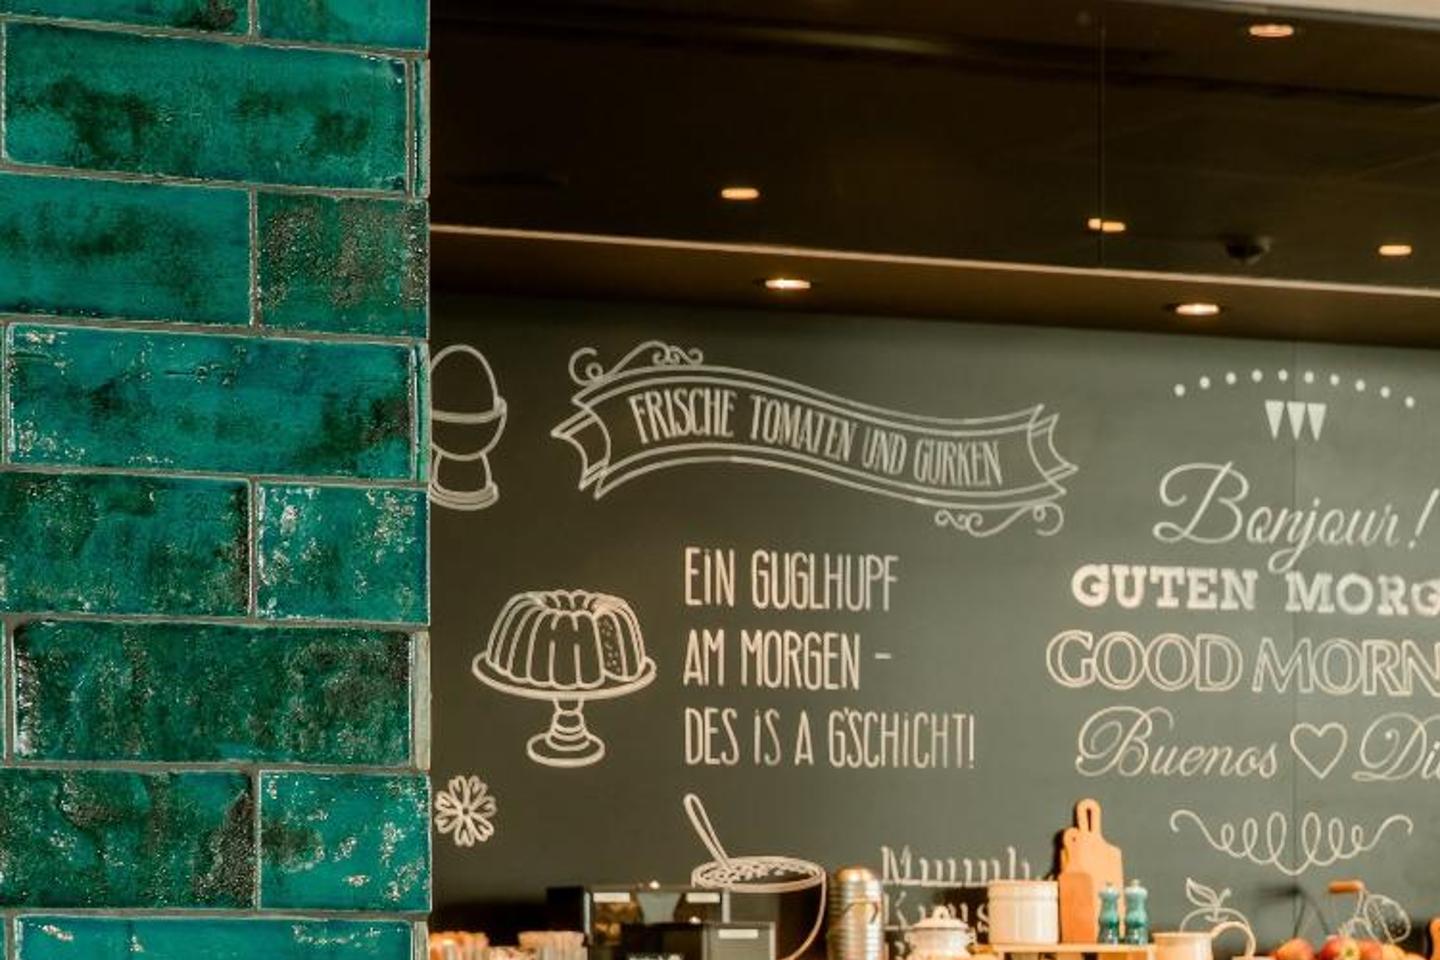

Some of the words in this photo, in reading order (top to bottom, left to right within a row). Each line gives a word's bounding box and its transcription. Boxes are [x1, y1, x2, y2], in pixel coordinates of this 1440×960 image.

[628, 386, 737, 446] FRISCHE
[748, 395, 858, 462] TOMATEN
[861, 426, 906, 475] UND
[912, 438, 1002, 487] GURKEN
[1152, 460, 1440, 574] Bonjour!
[751, 549, 900, 612] GUGLHUPF
[1071, 562, 1259, 611] GUTEN
[682, 628, 726, 688] AM
[740, 628, 862, 691] MORGEN
[1046, 628, 1243, 691] GOOD
[684, 706, 741, 767] DES
[793, 710, 815, 767] A
[1075, 705, 1279, 778] Buenos
